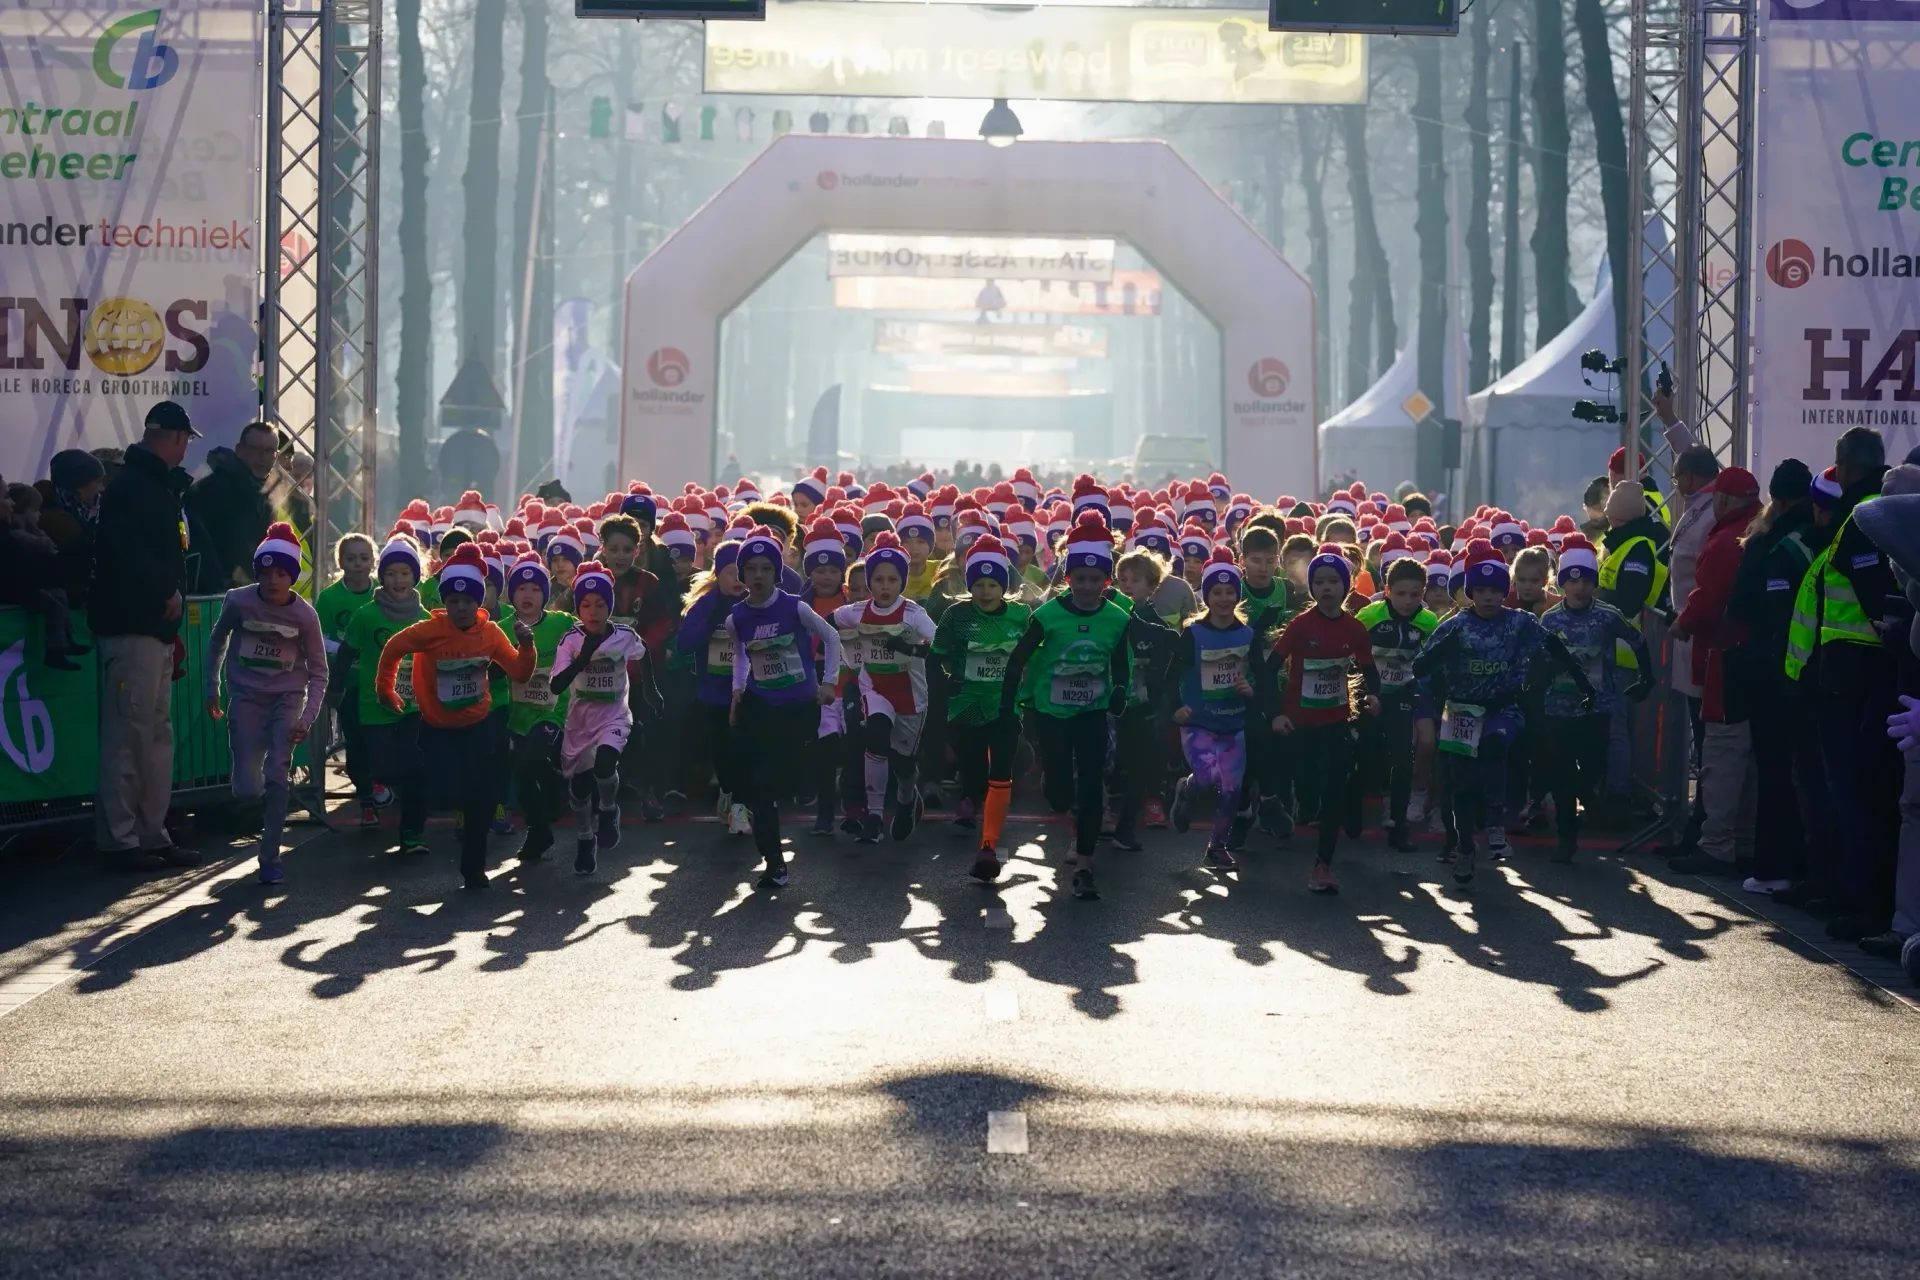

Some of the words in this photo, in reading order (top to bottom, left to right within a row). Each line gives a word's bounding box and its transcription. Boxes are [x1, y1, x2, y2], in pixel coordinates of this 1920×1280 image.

[841, 174, 920, 188] hollander
[0, 216, 94, 246] nder
[99, 218, 250, 249] techniek
[1823, 246, 1920, 278] holla
[32, 379, 90, 394] HORECA
[101, 380, 210, 396] GROOTHANDEL
[632, 387, 705, 404] hollander
[1233, 400, 1307, 414] hollander
[1803, 409, 1918, 426] INTERNATIONAL
[753, 622, 780, 640] NIKE
[253, 644, 282, 658] J2142
[763, 661, 789, 676] J2081
[451, 682, 477, 696] J2153
[586, 676, 614, 688] J2156
[1062, 690, 1094, 701] M2297
